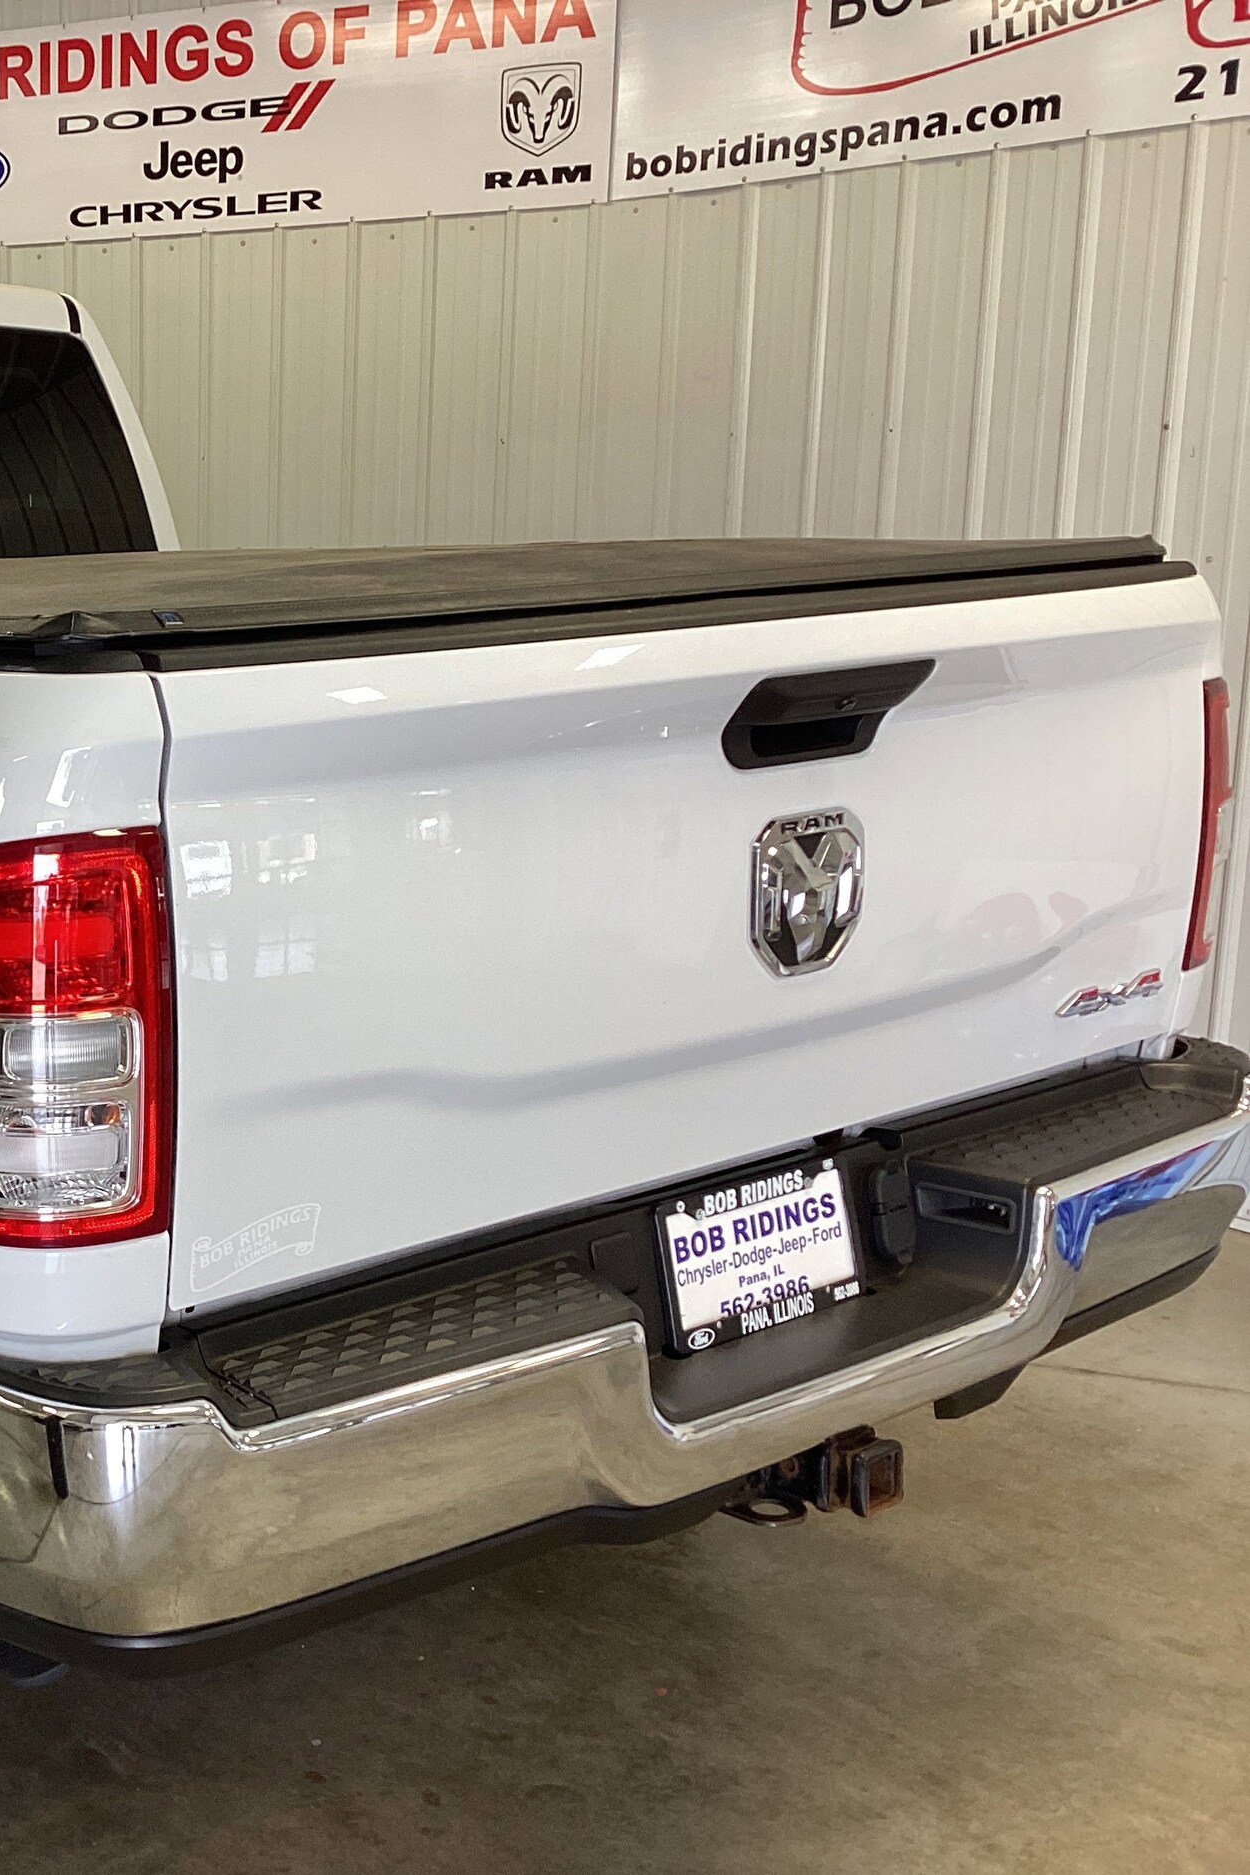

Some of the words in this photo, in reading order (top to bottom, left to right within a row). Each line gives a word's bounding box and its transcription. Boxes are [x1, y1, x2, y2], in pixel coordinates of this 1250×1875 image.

[278, 4, 370, 70] OF
[394, 0, 597, 59] PANA
[969, 0, 1136, 55] ILLINO
[58, 95, 293, 135] DODGE
[625, 93, 1063, 181] bobridingspana.com
[143, 141, 243, 183] Jeep
[484, 164, 592, 190] RAM
[69, 189, 323, 227] CHRYSLER
[781, 812, 844, 835] RAM
[704, 1189, 737, 1216] BOB
[740, 1169, 804, 1207] RIDINGS
[200, 1241, 234, 1268] BOB
[239, 1207, 310, 1248] RIDINGS
[674, 1225, 726, 1264] BOB
[733, 1193, 836, 1245] RIDINGS
[677, 1221, 842, 1287] Chrysler-Dodge-Jeep-Ford
[739, 1271, 770, 1287] Pana,
[773, 1263, 785, 1276] IL
[773, 1291, 815, 1324] ILLINOIS
